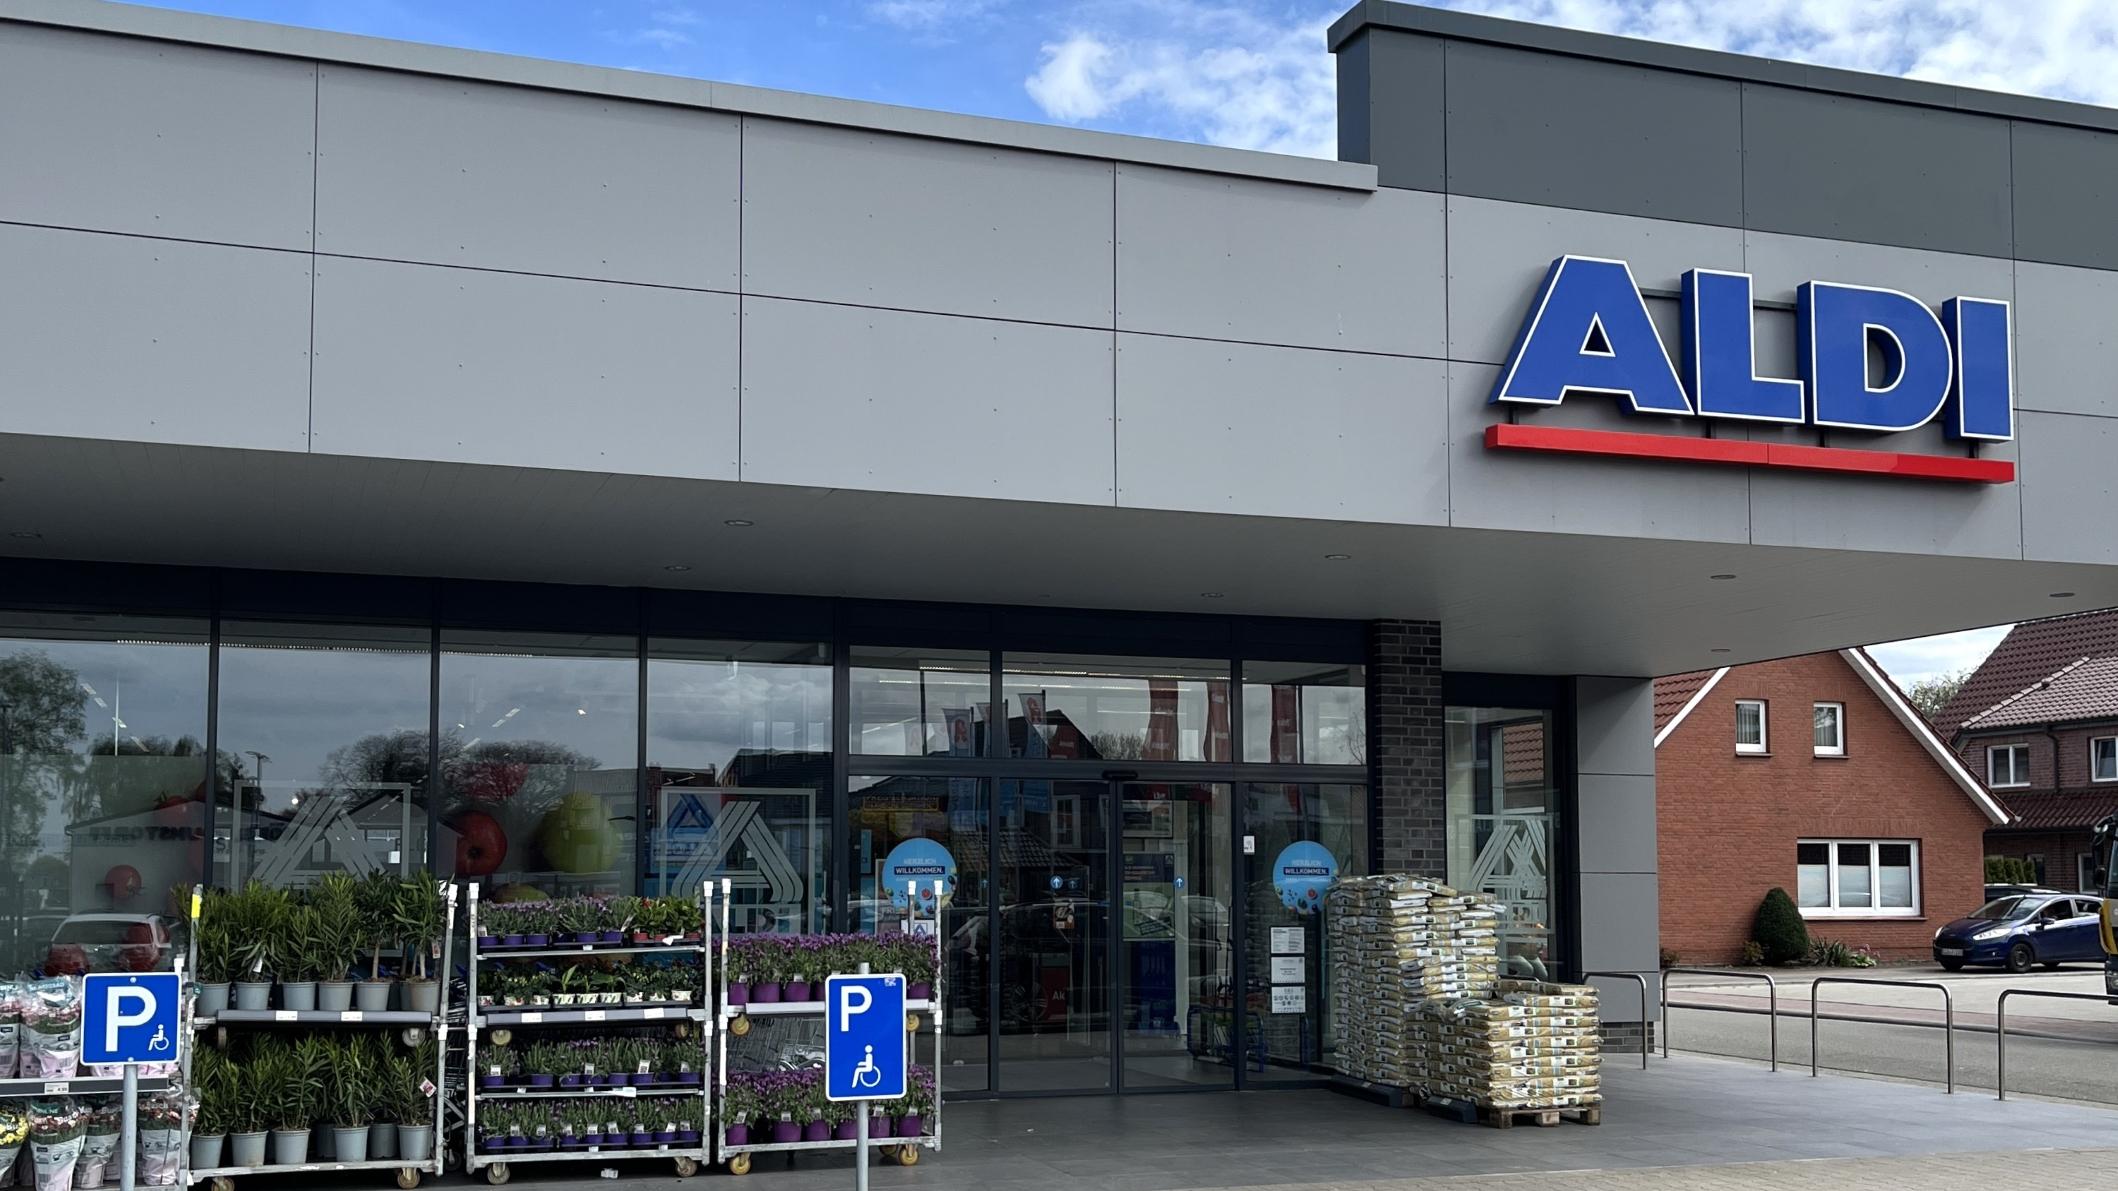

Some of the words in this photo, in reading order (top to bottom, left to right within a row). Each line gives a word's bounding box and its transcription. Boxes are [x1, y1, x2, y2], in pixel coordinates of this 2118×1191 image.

[1490, 254, 2015, 441] ALDI
[105, 985, 157, 1052] P
[841, 985, 873, 1032] P
